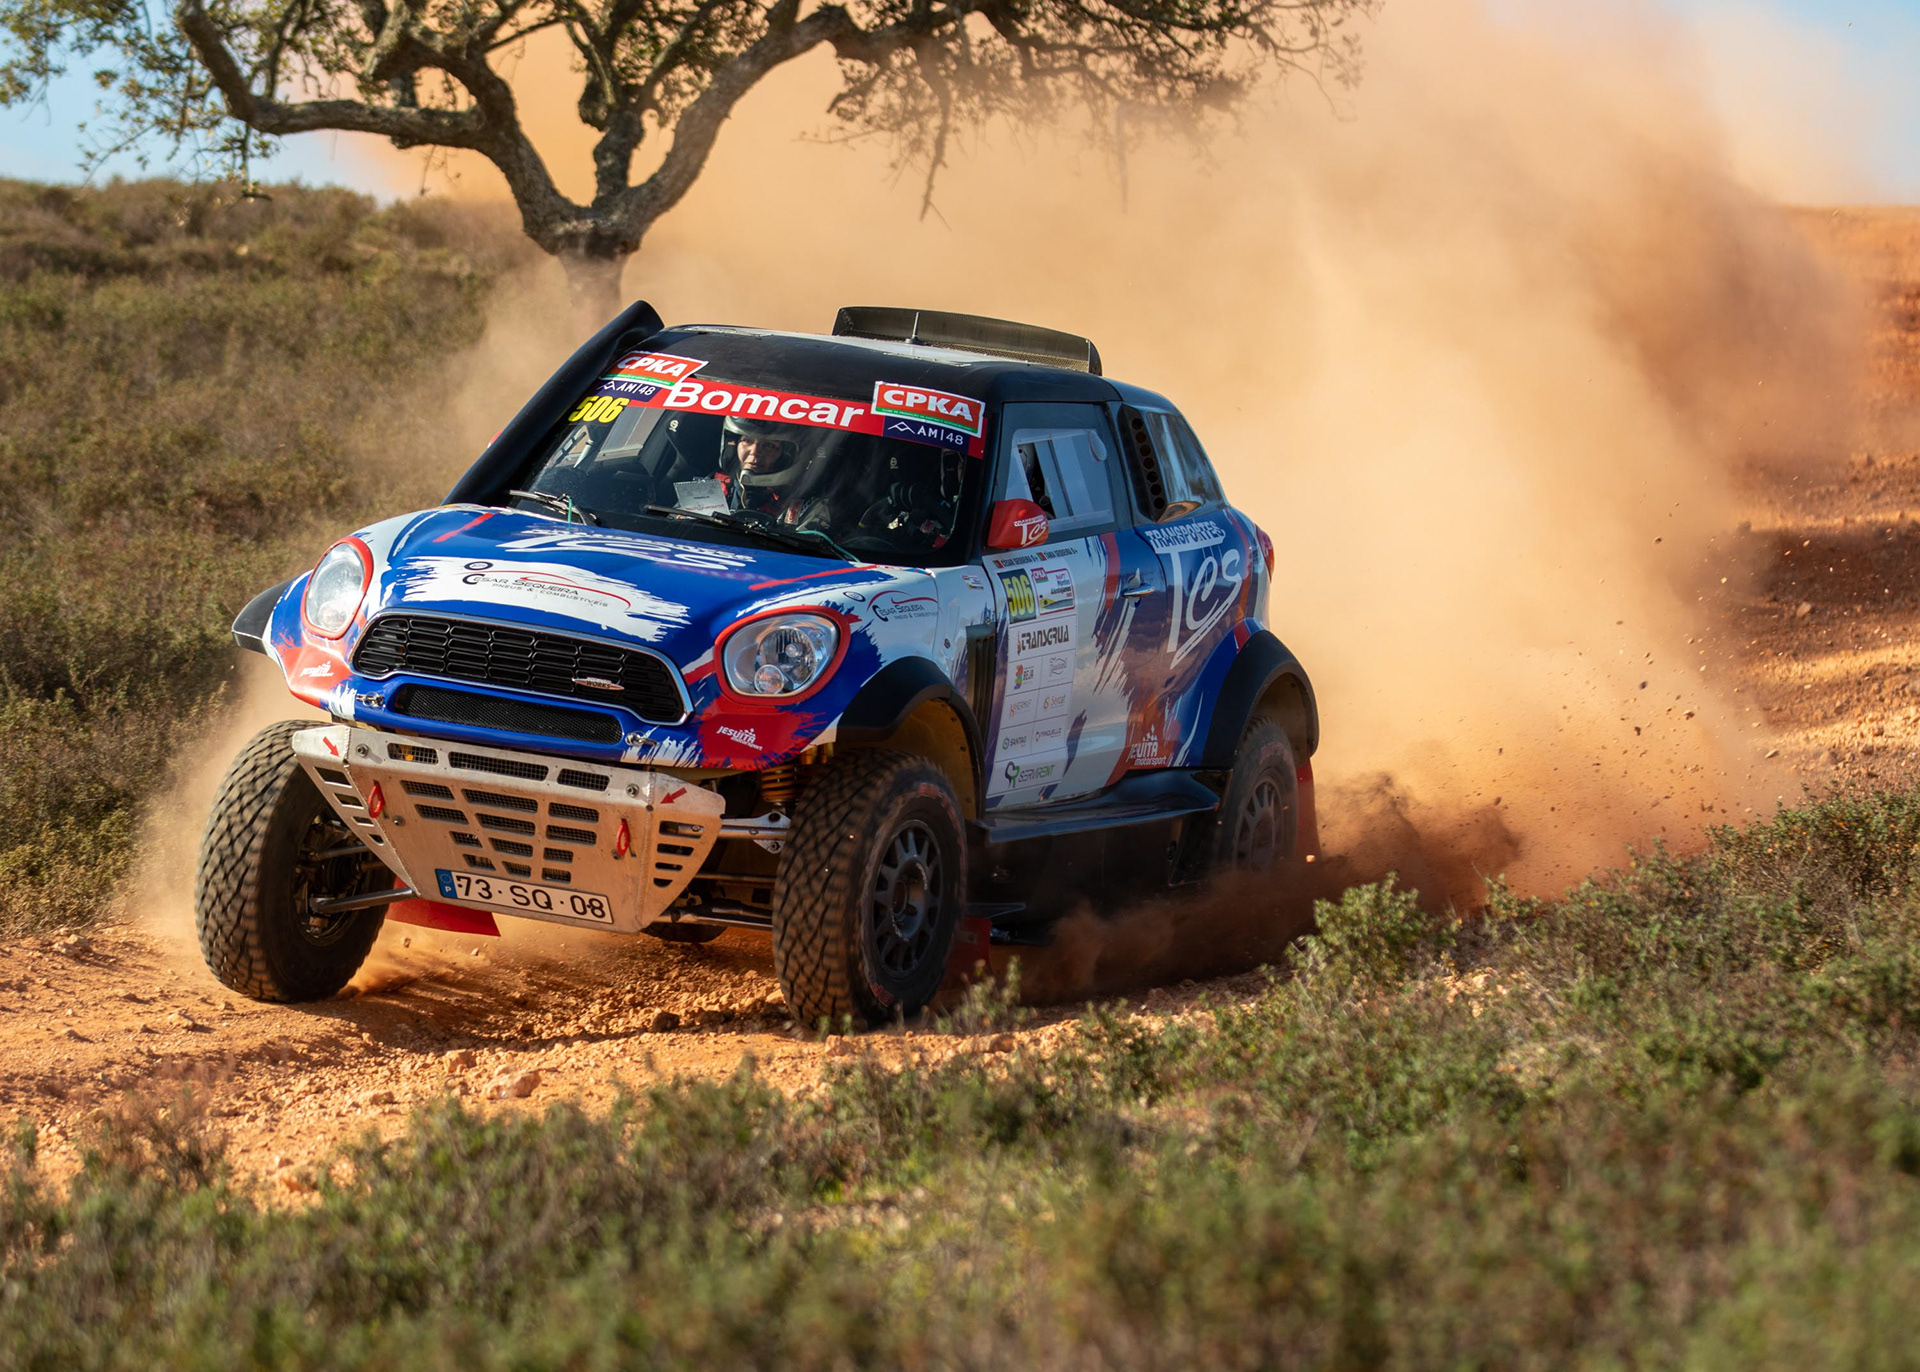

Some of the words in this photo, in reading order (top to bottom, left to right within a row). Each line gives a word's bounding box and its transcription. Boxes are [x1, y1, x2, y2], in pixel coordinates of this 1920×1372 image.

[617, 357, 688, 377] CPKA
[568, 396, 630, 423] 506
[663, 382, 864, 427] Bomcar
[883, 390, 973, 421] CPKA
[1145, 521, 1225, 549] TRANSPORTES
[512, 578, 579, 595] SEQUEIRA
[1002, 574, 1035, 617] 506
[444, 885, 452, 893] P
